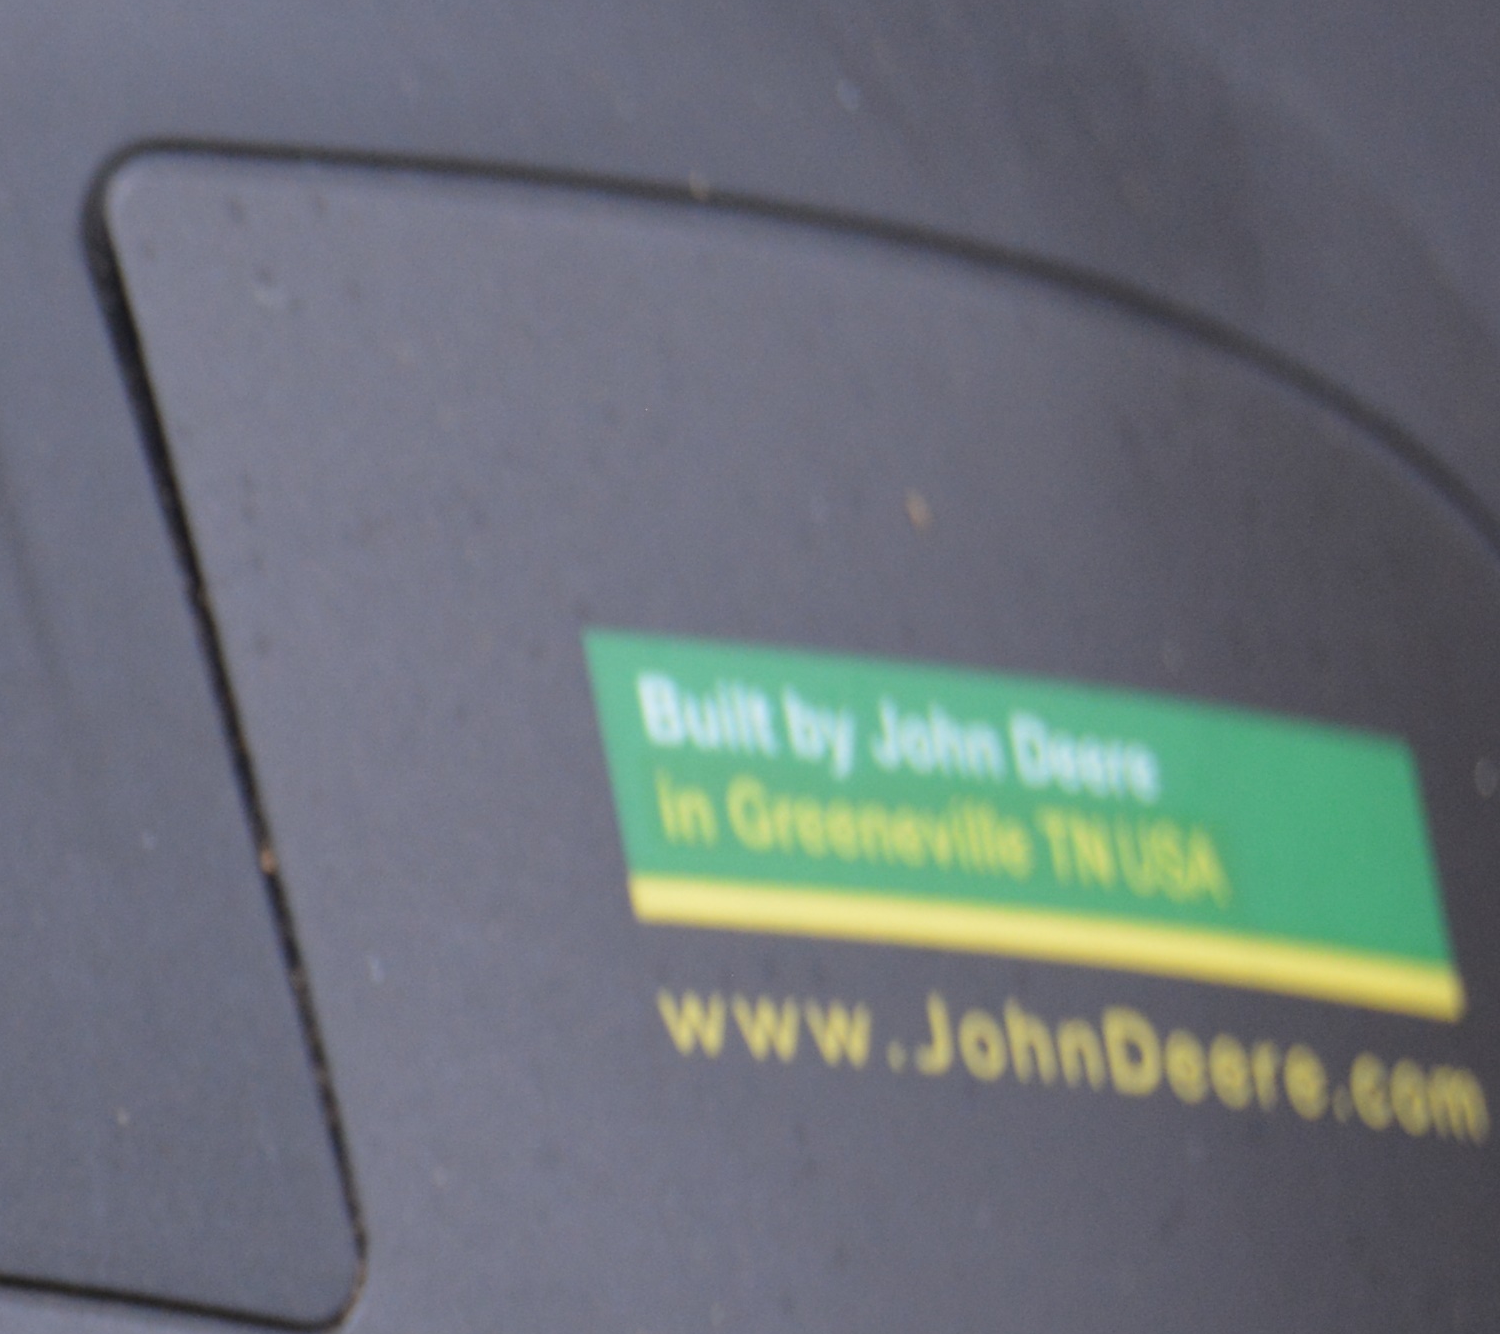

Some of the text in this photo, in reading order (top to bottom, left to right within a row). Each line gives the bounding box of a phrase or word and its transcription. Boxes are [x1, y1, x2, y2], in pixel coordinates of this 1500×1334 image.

[635, 670, 1160, 805] Built by John Deere
[655, 769, 717, 849] in
[656, 988, 1491, 1146] www.JohnDeere.com
